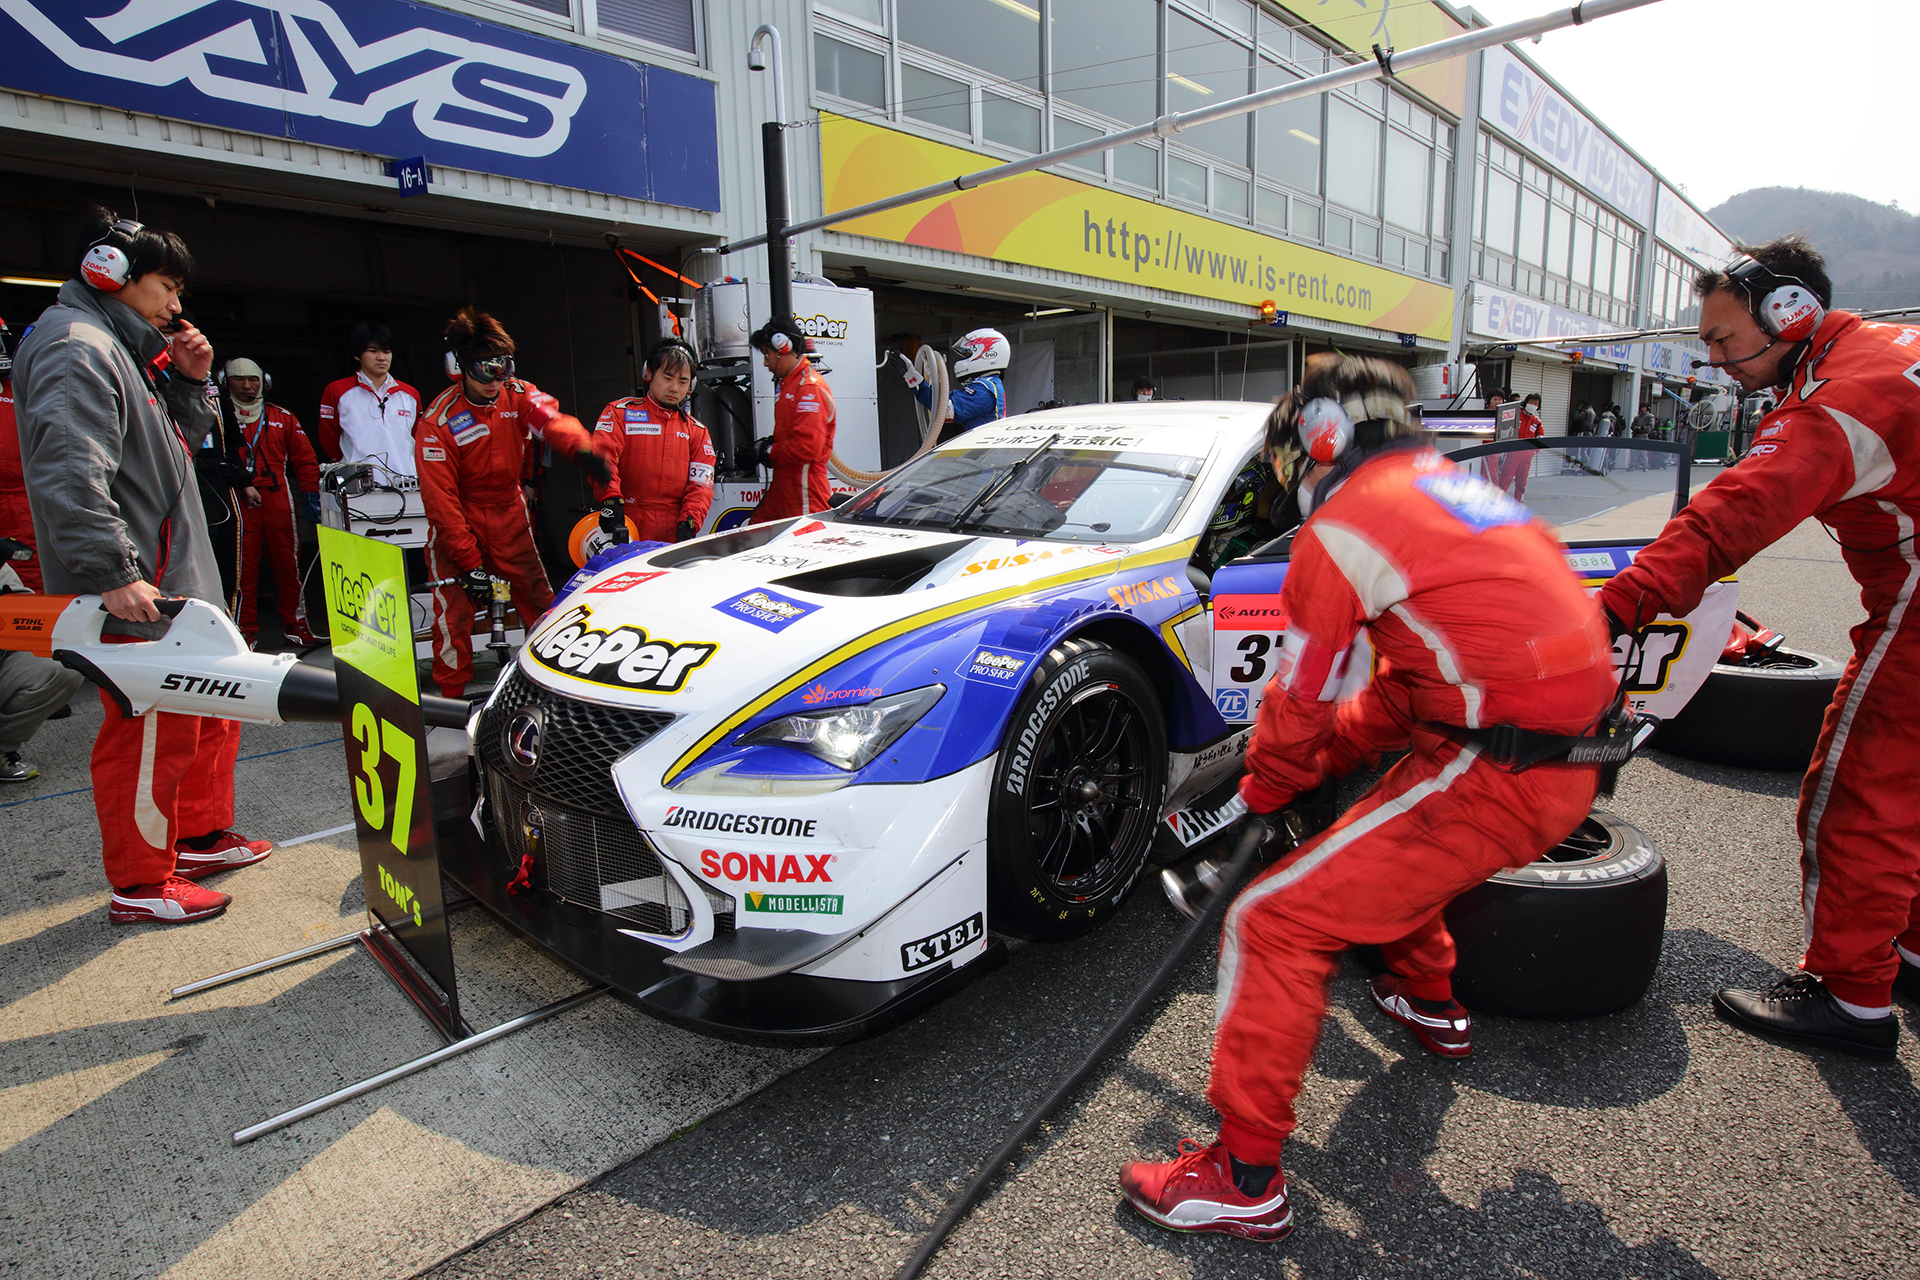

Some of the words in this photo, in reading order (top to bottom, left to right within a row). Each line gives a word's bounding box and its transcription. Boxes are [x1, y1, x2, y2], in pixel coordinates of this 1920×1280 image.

[1500, 62, 1589, 172] EXEDY
[401, 166, 424, 189] 16-A
[1084, 209, 1372, 311] http://www.is-rent.com
[793, 313, 847, 339] eePer
[1487, 295, 1544, 339] EXEDY
[1781, 304, 1812, 325] TOM'S
[331, 561, 396, 640] KeePer
[1107, 576, 1182, 607] SUSAS
[730, 600, 751, 615] PRO
[750, 605, 785, 624] SHOP
[740, 592, 805, 618] KeePer
[1237, 608, 1282, 617] AUTO
[12, 618, 45, 626] STIHL
[386, 645, 397, 658] LIFE
[528, 604, 721, 695] KeePer
[973, 651, 1025, 671] KeePer
[969, 664, 988, 676] PRO
[988, 667, 1015, 681] SHOP
[160, 674, 246, 699] STIHL
[823, 687, 882, 702] promina
[1219, 695, 1246, 713] ZF
[1007, 659, 1090, 796] BRIDGESTONE
[352, 702, 416, 856] 37
[662, 805, 817, 838] BRIDGESTONE
[700, 849, 832, 883] SONAX
[378, 864, 422, 928] TOM'S
[768, 897, 839, 912] MODELLISTA
[905, 918, 982, 968] KTEL
